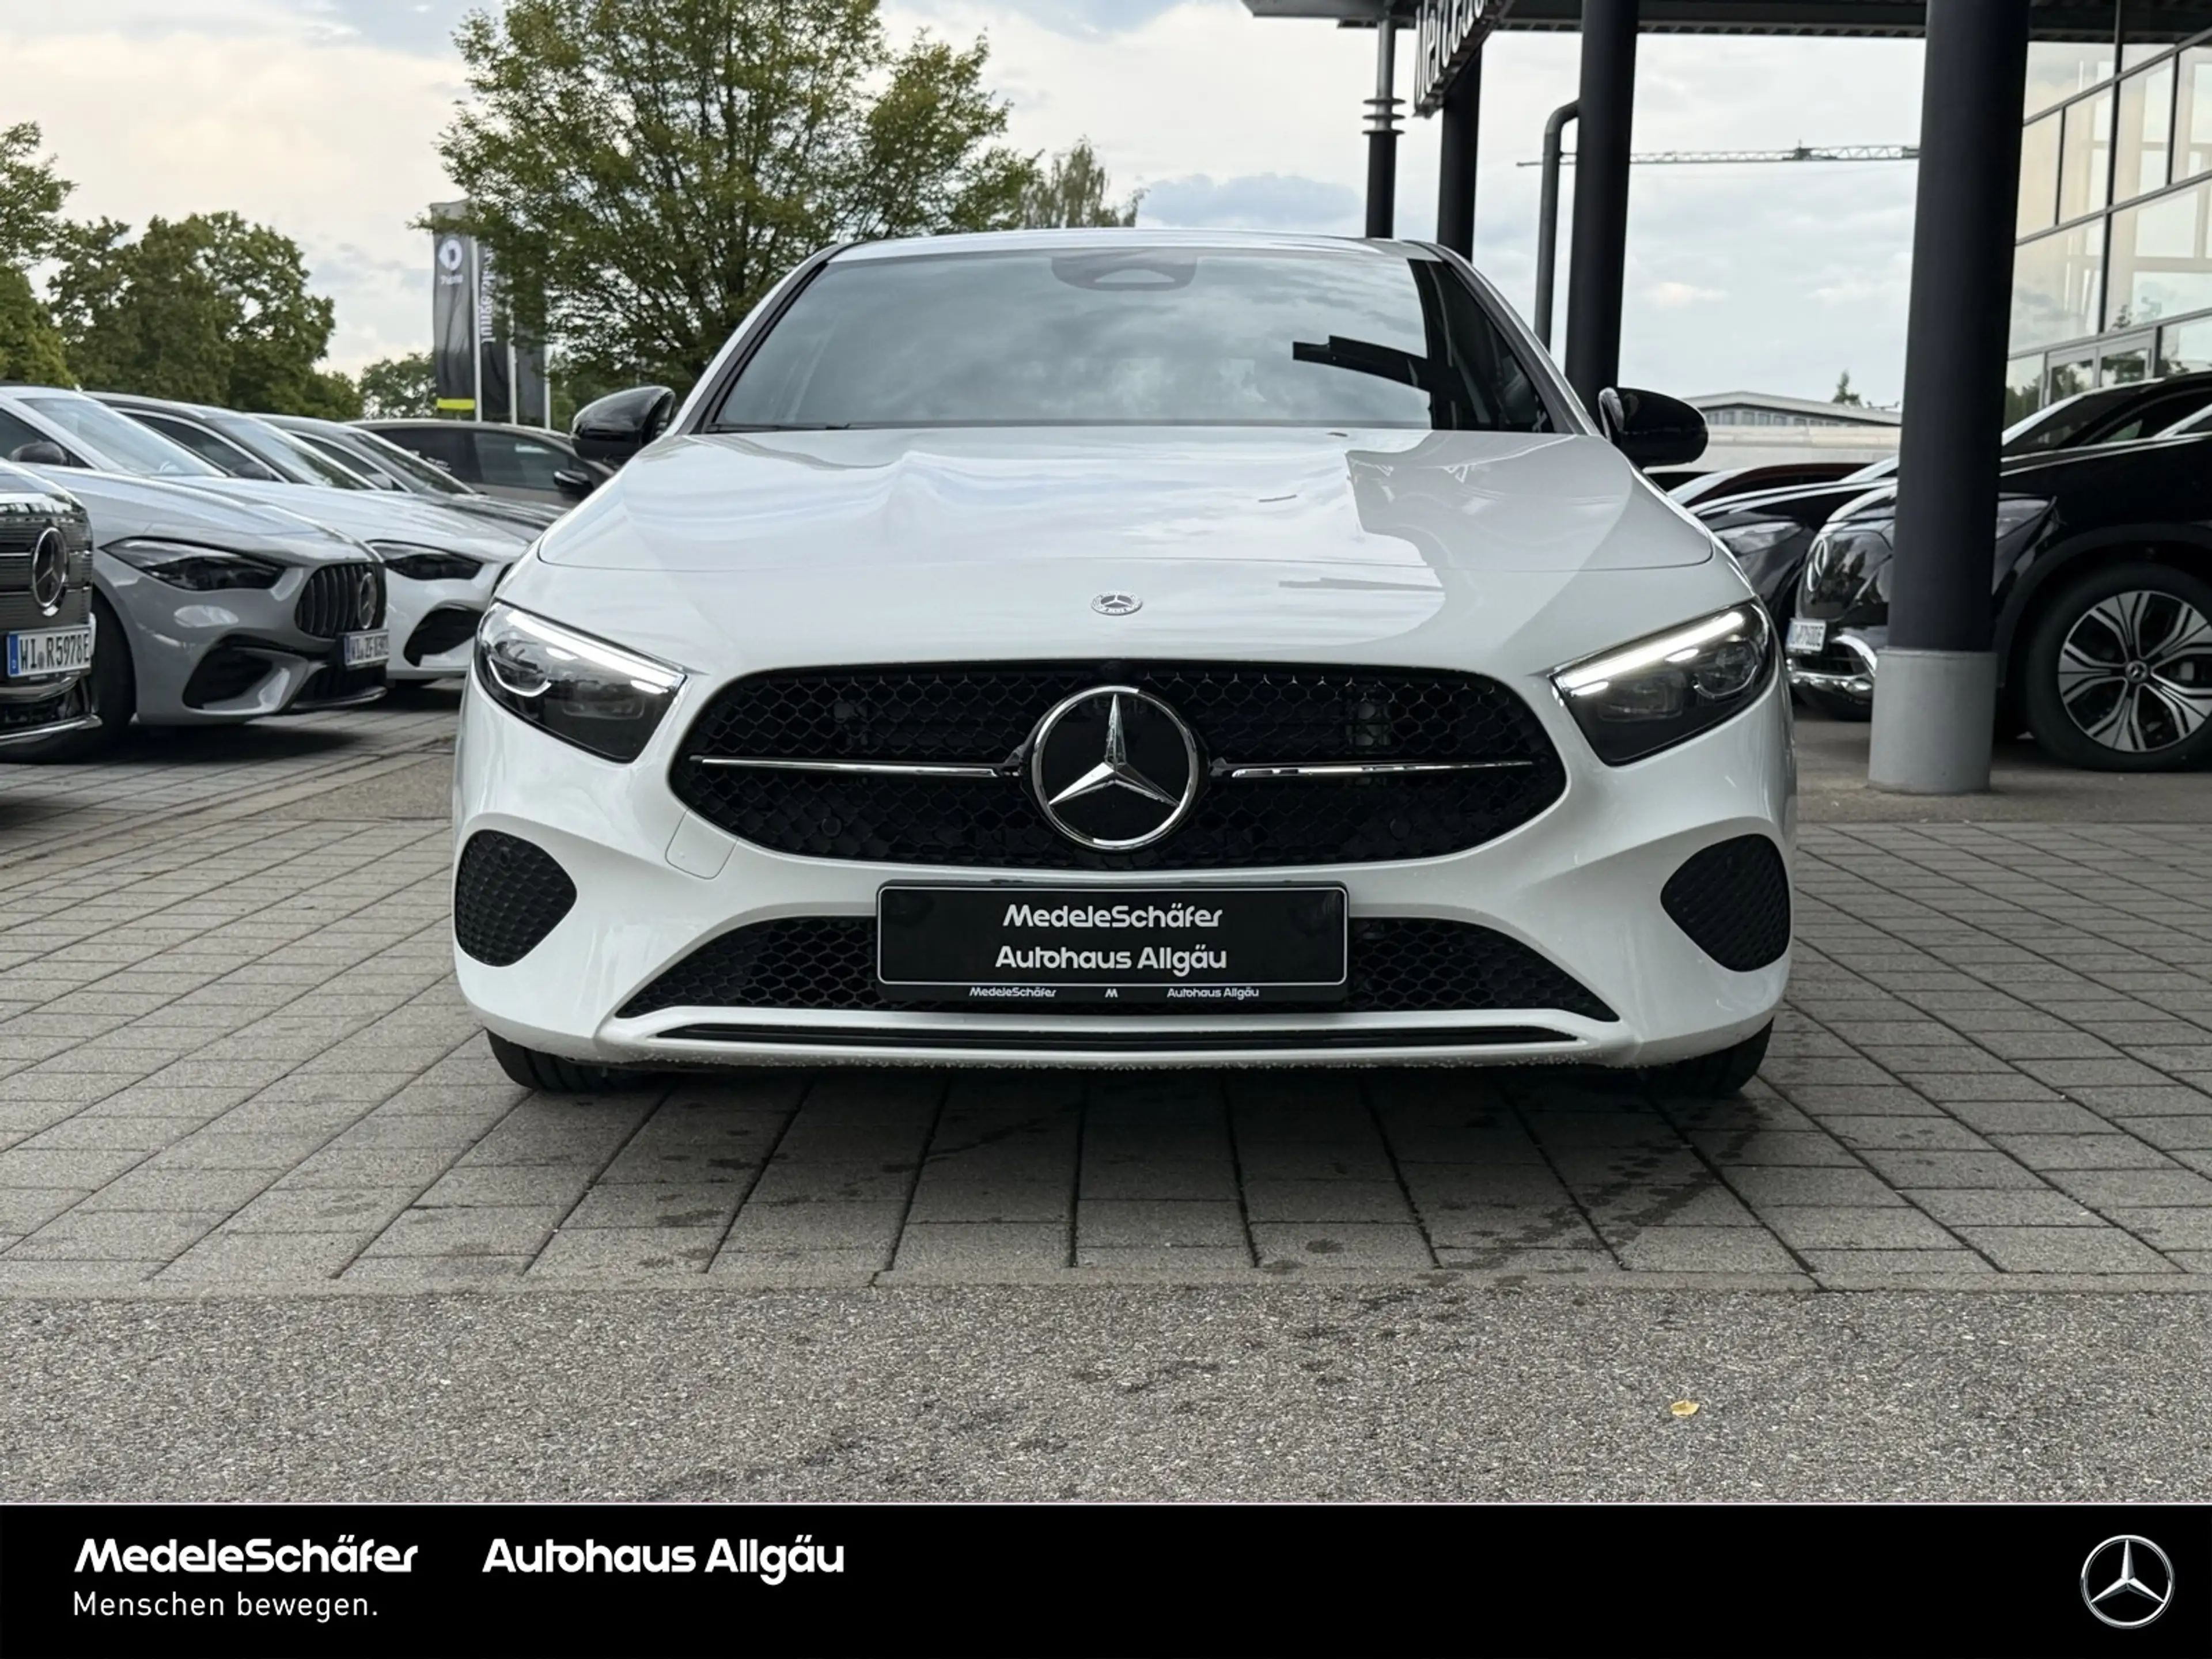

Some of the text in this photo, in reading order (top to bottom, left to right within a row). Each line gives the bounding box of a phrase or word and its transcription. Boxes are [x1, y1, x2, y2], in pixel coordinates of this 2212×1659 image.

[20, 638, 36, 671] WI
[1002, 903, 1223, 928] MedeleSchäfer
[995, 945, 1226, 977] Autohaus Allgäu
[969, 987, 1056, 998] MedeleSchäfer
[1167, 987, 1221, 998] Autohaus
[1224, 987, 1259, 1000] Allgäu
